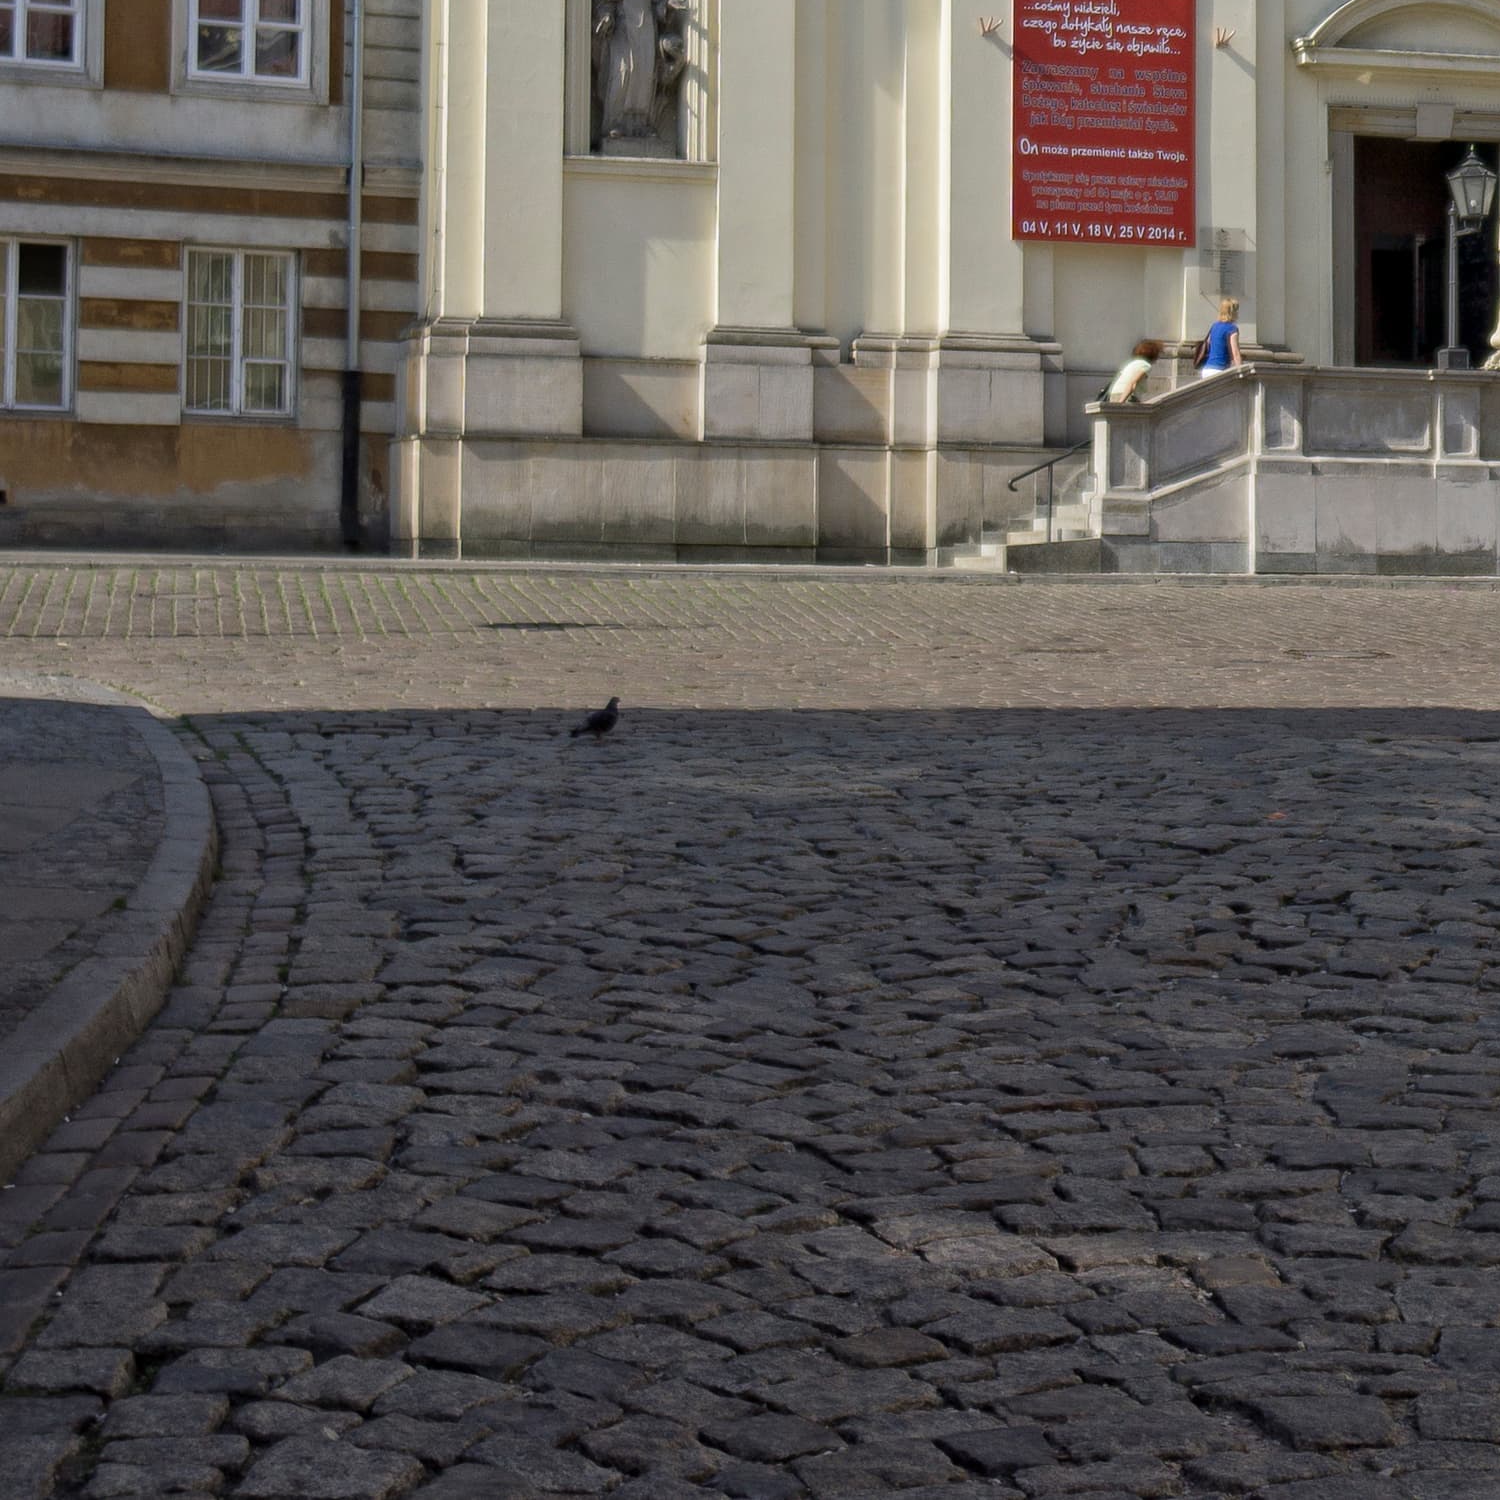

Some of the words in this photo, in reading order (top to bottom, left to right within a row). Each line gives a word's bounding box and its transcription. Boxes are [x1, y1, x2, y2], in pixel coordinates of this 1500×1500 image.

[1023, 19, 1058, 34] czego
[1060, 16, 1113, 38] dotykały
[1116, 24, 1154, 36] nasze
[1156, 27, 1187, 39] ręce,
[1052, 32, 1067, 48] bo
[1070, 36, 1103, 55] życie
[1022, 61, 1099, 80] Zapraszamy
[1134, 68, 1187, 84] wspólne
[1020, 137, 1039, 155] On
[1041, 145, 1069, 155] może
[1071, 147, 1126, 158] przemienić
[1128, 148, 1154, 160] także
[1156, 150, 1189, 163] Twoje.
[1022, 221, 1036, 233] 04
[1039, 221, 1051, 236] V,
[1055, 223, 1068, 235] 11
[1072, 223, 1084, 238] V,
[1088, 224, 1101, 237] 18
[1104, 225, 1116, 239] V,
[1119, 225, 1133, 238] 25
[1137, 226, 1145, 239] V
[1148, 227, 1175, 241] 2014
[1178, 229, 1187, 241] r.
